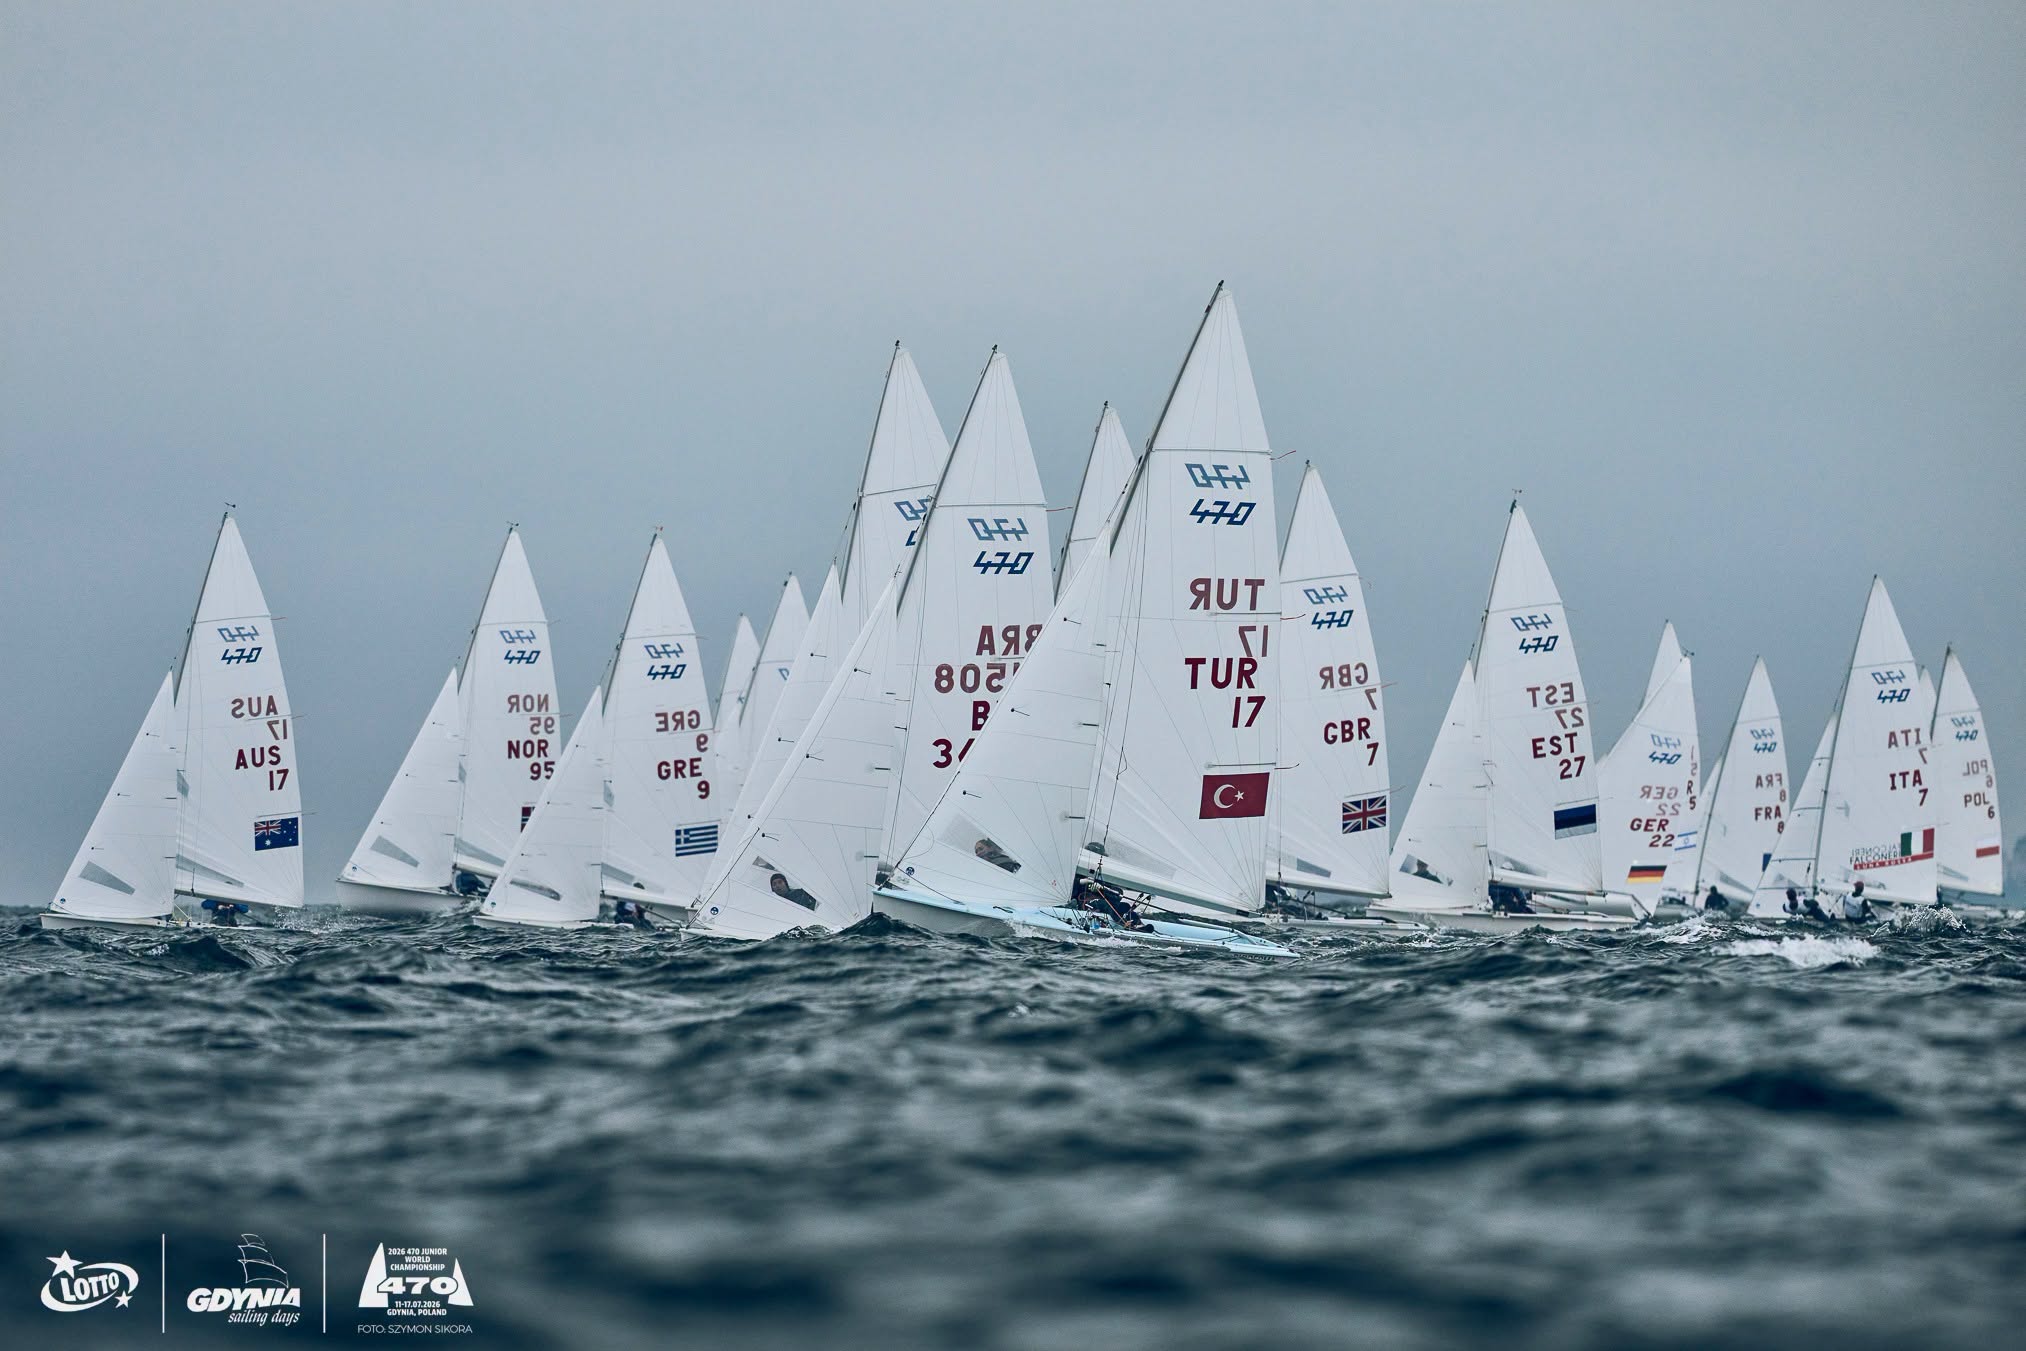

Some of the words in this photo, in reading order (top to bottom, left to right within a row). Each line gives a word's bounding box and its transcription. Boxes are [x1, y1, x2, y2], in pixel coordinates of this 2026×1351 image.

[1189, 499, 1256, 526] 470
[973, 551, 1034, 574] 470
[1311, 609, 1354, 630] 470
[1519, 635, 1559, 654] 470
[221, 646, 262, 665] 470
[504, 650, 541, 664] 470
[647, 664, 687, 680] 470
[1185, 657, 1258, 690] TUR
[1877, 688, 1911, 704] 470
[1232, 695, 1266, 728] 17
[1323, 717, 1371, 745] GBR
[1955, 729, 1978, 742] 470
[507, 739, 549, 759] NOR
[1366, 742, 1379, 766] 7
[1531, 732, 1578, 759] EST
[1754, 741, 1777, 753] 470
[235, 745, 281, 770] AUS
[1559, 755, 1586, 780] 27
[1649, 751, 1682, 764] 470
[530, 761, 555, 781] 95
[657, 757, 702, 780] GRE
[269, 768, 289, 791] 17
[1889, 769, 1922, 791] ITA
[697, 780, 710, 800] 9
[1918, 788, 1928, 807] 7
[1964, 792, 1990, 808] POL
[1689, 796, 1696, 810] 5
[1755, 805, 1781, 821] FRA
[1987, 805, 1995, 819] 6
[1630, 818, 1669, 832] GER
[1649, 834, 1675, 848] 22
